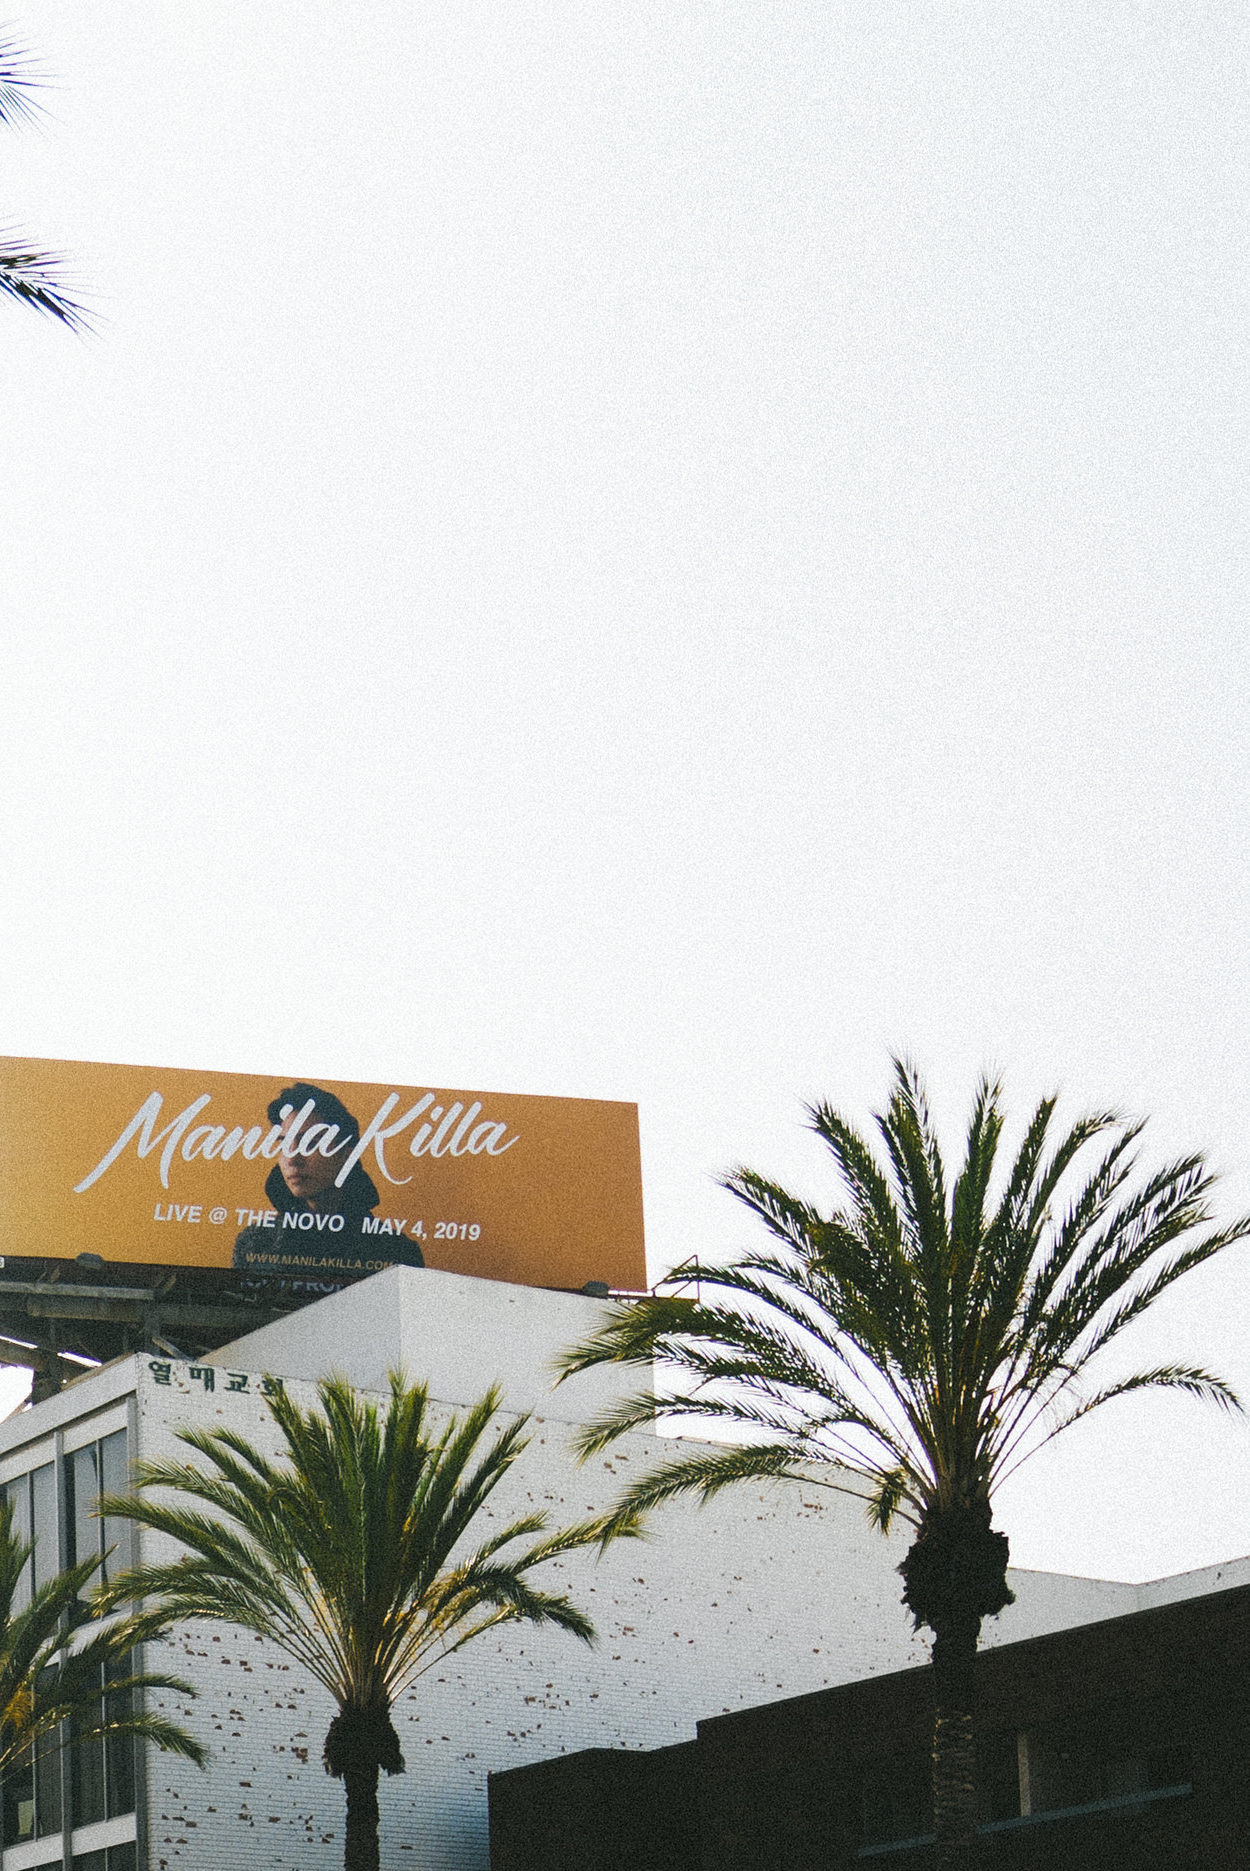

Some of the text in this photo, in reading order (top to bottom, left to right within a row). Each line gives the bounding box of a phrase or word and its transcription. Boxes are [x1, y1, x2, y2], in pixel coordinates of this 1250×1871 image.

[72, 1090, 520, 1193] Manila Killa
[153, 1203, 481, 1242] LIVE @ THE NOVO MAY 4, 2019
